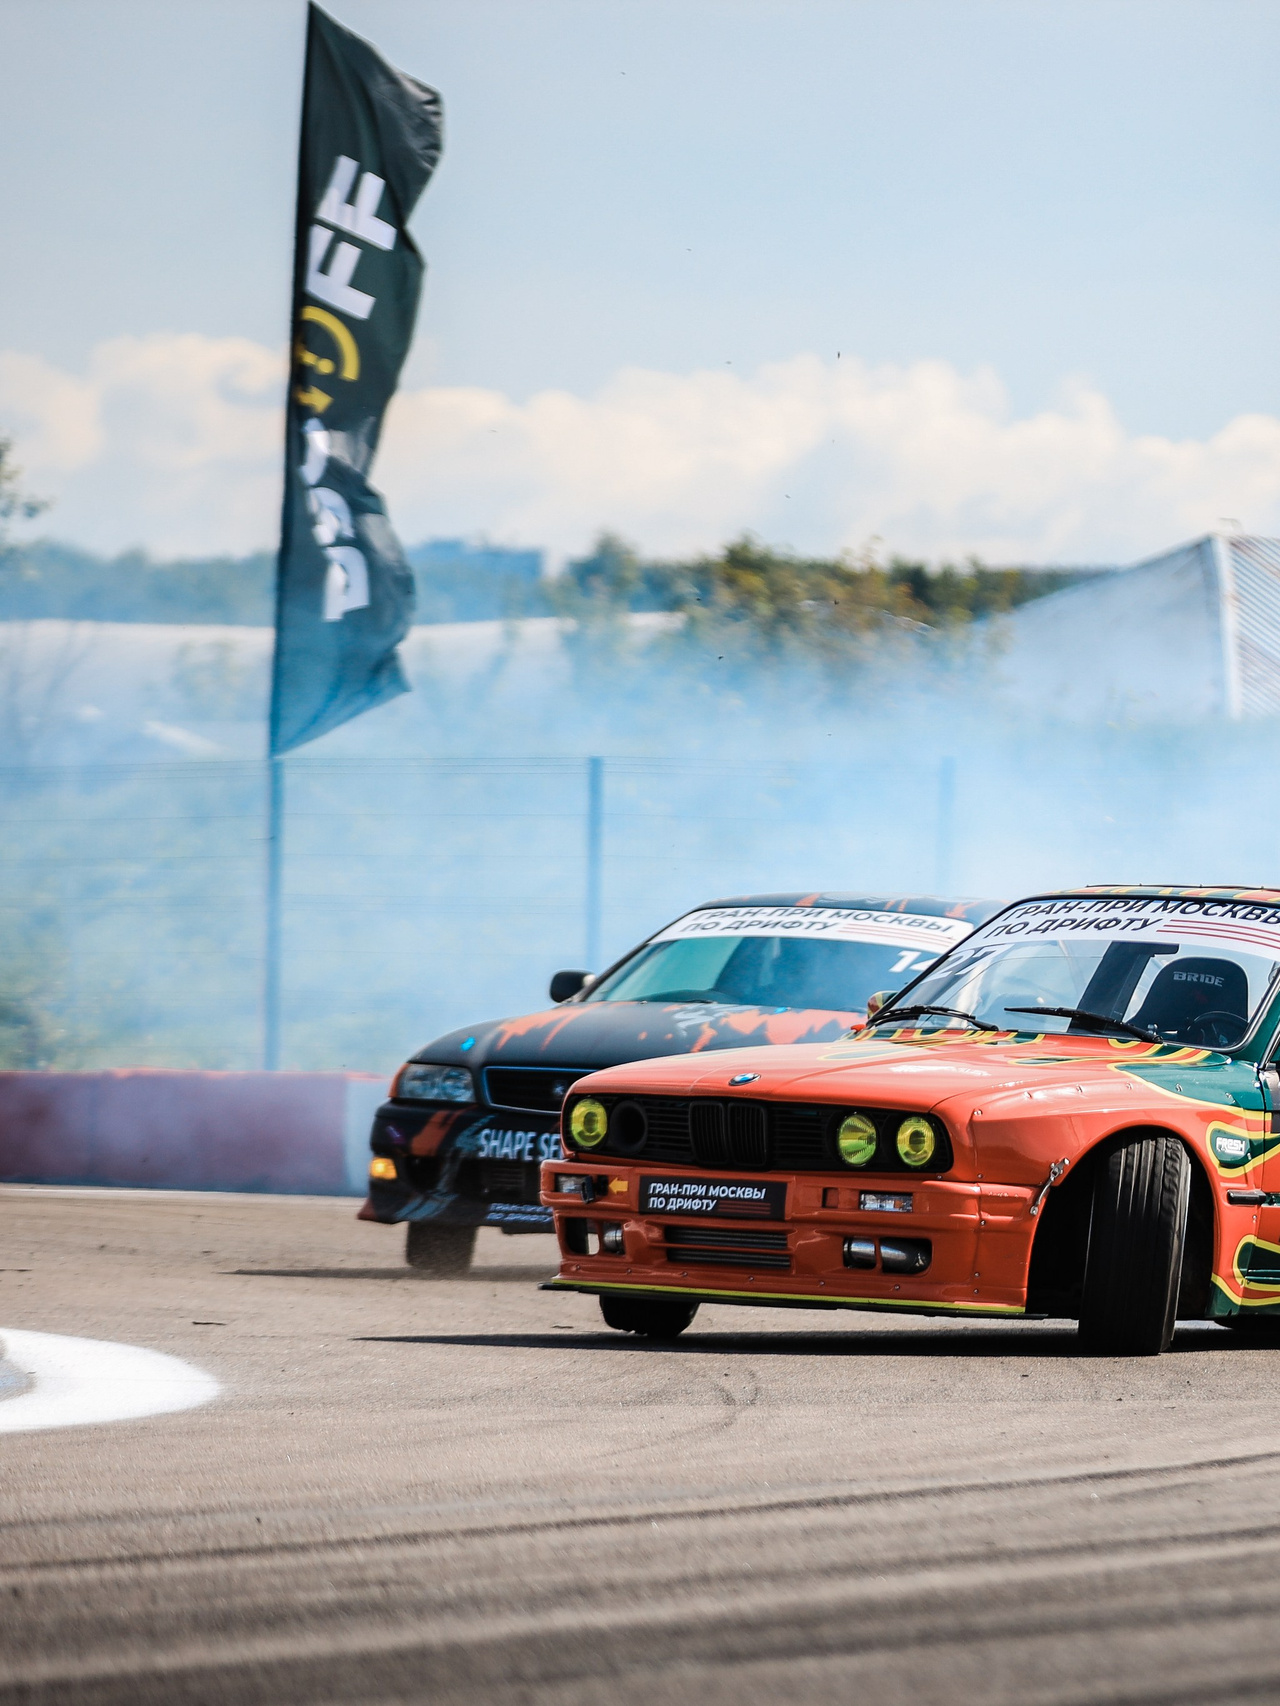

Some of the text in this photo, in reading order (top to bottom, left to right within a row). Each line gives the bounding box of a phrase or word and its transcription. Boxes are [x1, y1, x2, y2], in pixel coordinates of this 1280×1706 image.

[1002, 899, 1152, 921] ГРАН-ПРИ
[680, 919, 838, 932] ПО ДРИФТУ
[828, 909, 956, 933] МОСКВЫ
[983, 915, 1164, 939] ПО ДРИФТУ
[1172, 970, 1225, 987] BRIDE
[479, 1128, 537, 1160] SHAPE
[649, 1182, 766, 1199] ГРАН-ПРИ МОСКВЫ
[649, 1197, 717, 1211] ПО ДРИФТУ
